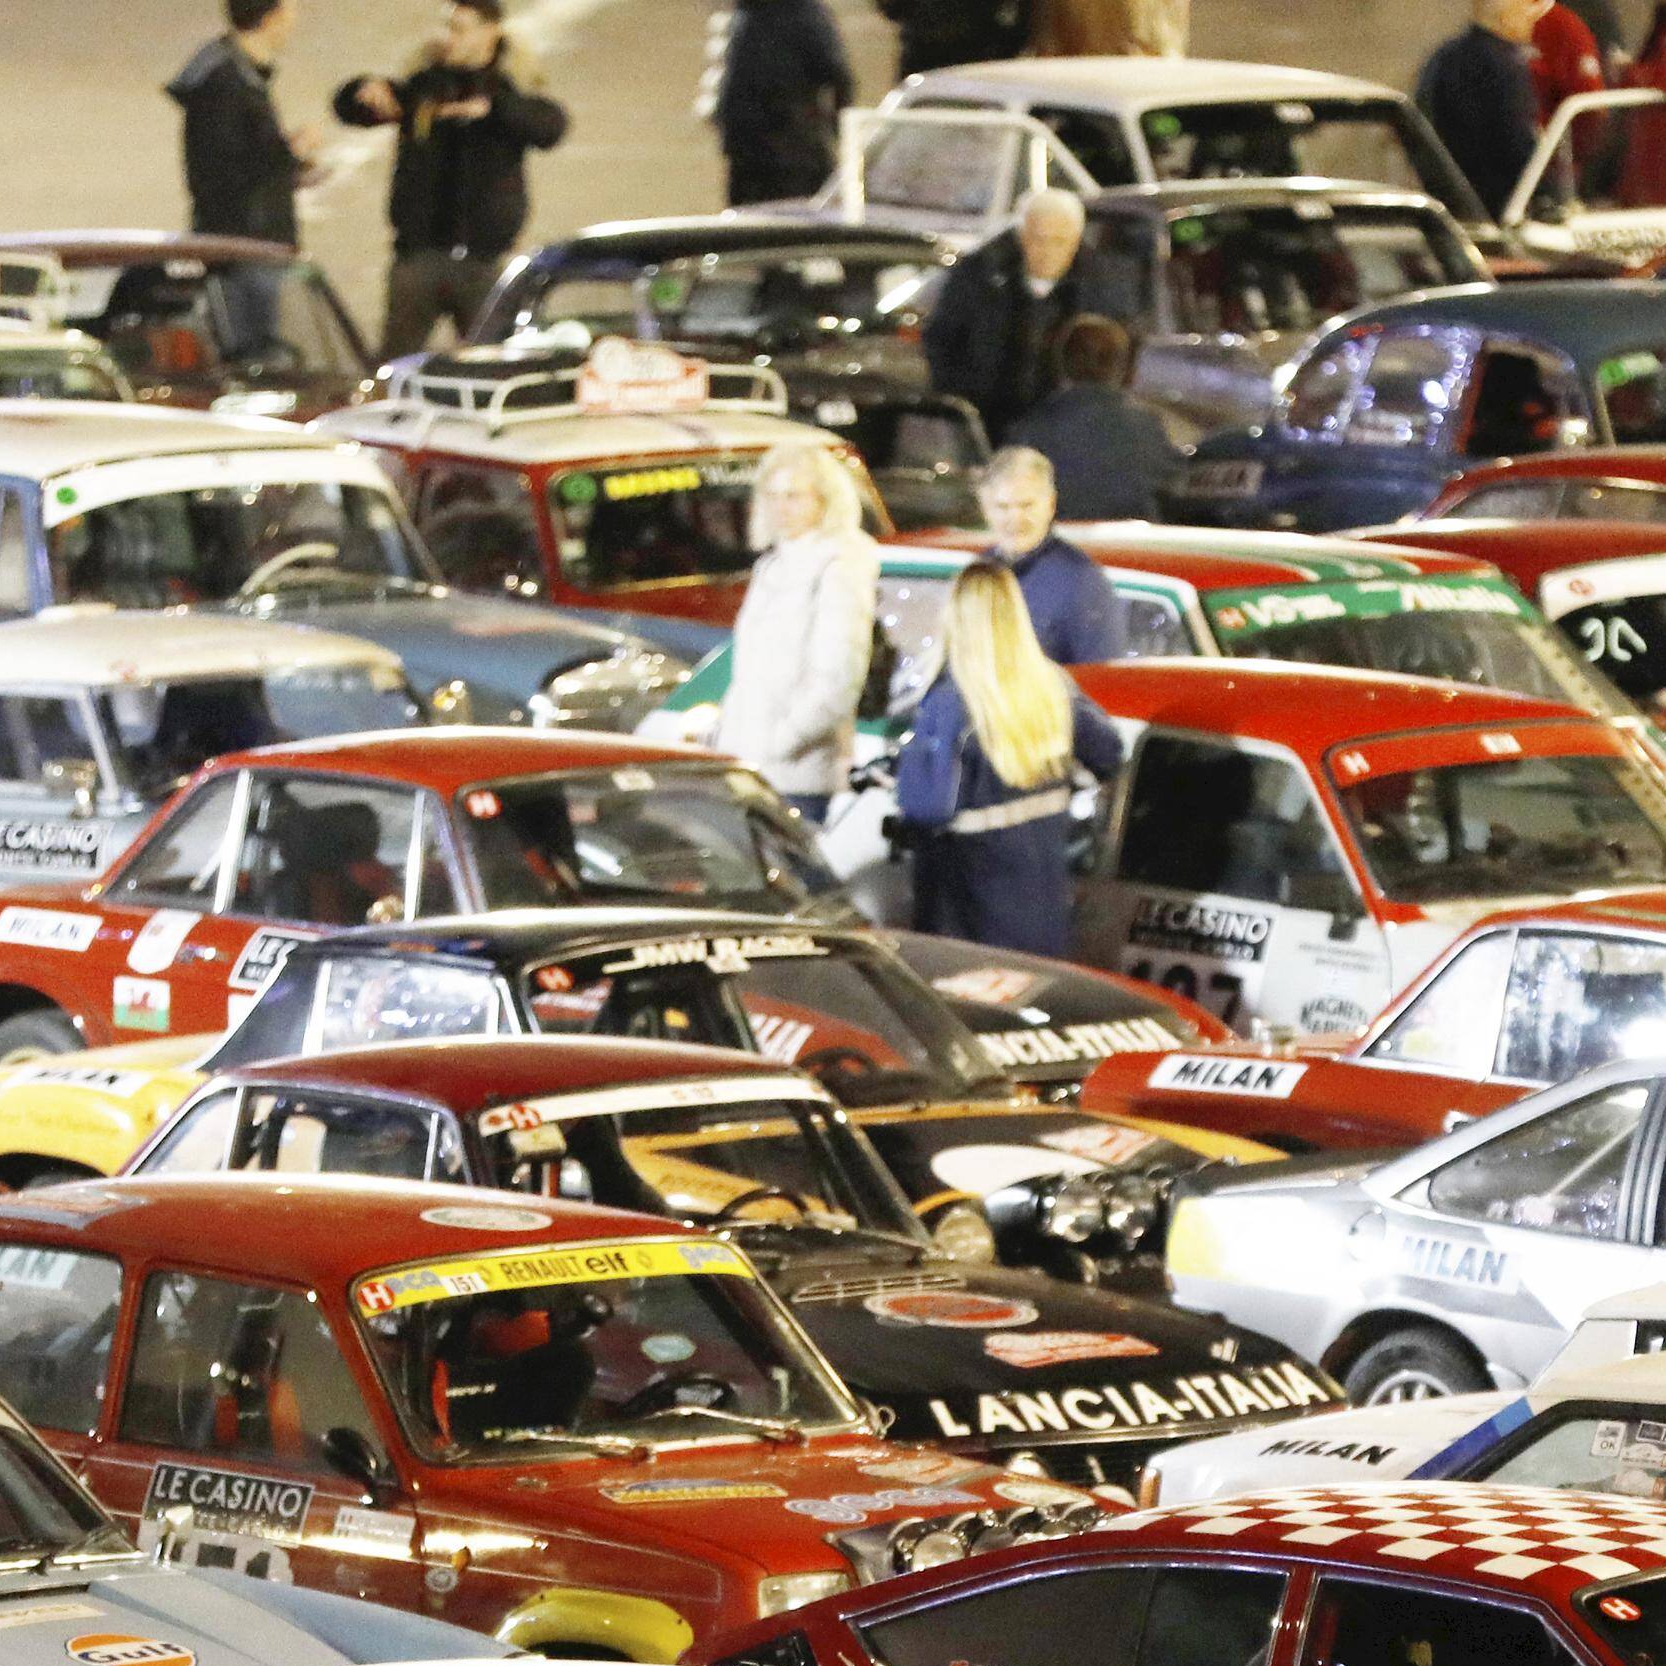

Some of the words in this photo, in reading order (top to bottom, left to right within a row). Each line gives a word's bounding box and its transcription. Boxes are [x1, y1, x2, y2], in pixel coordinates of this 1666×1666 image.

[1172, 1060, 1285, 1091] MILAN
[366, 1283, 393, 1311] H
[500, 1256, 580, 1284] RENAULT
[583, 1252, 630, 1279] elf
[930, 1359, 1329, 1438] LANCIA-ITALIA
[1258, 1437, 1397, 1468] MILAN
[155, 1468, 185, 1499] LE
[189, 1475, 302, 1519] CASINO
[1603, 1599, 1639, 1620] H
